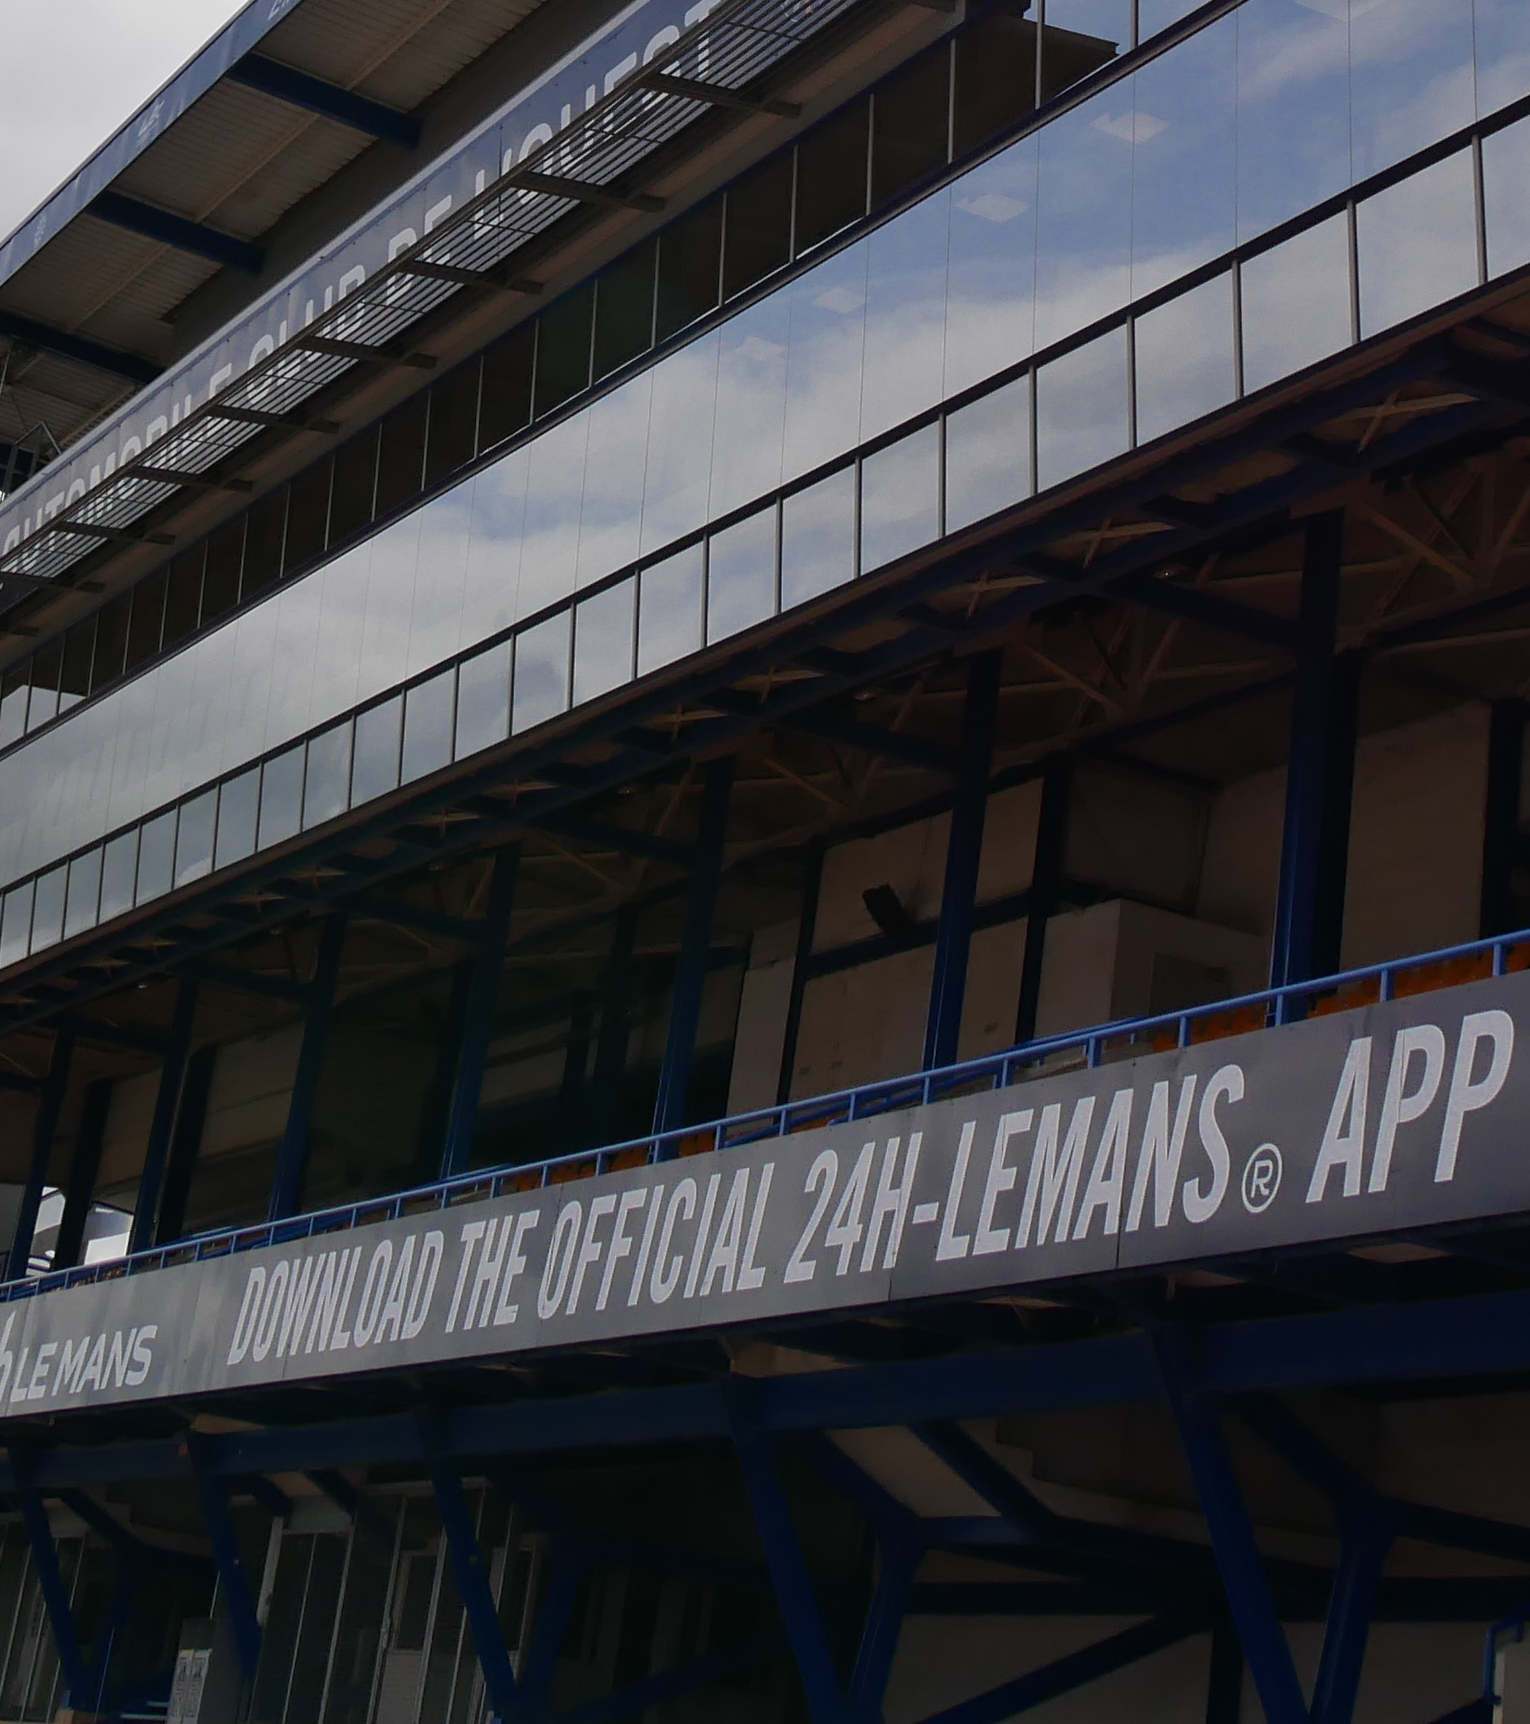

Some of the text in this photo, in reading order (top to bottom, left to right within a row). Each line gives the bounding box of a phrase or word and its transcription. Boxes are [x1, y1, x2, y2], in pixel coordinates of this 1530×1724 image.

[227, 1230, 444, 1367] DOWNLOAD
[445, 1209, 540, 1334] THE
[537, 1162, 775, 1320] OFFICIAL
[1305, 1009, 1515, 1204] APP
[10, 1342, 58, 1403] LE
[51, 1324, 159, 1397] MANS
